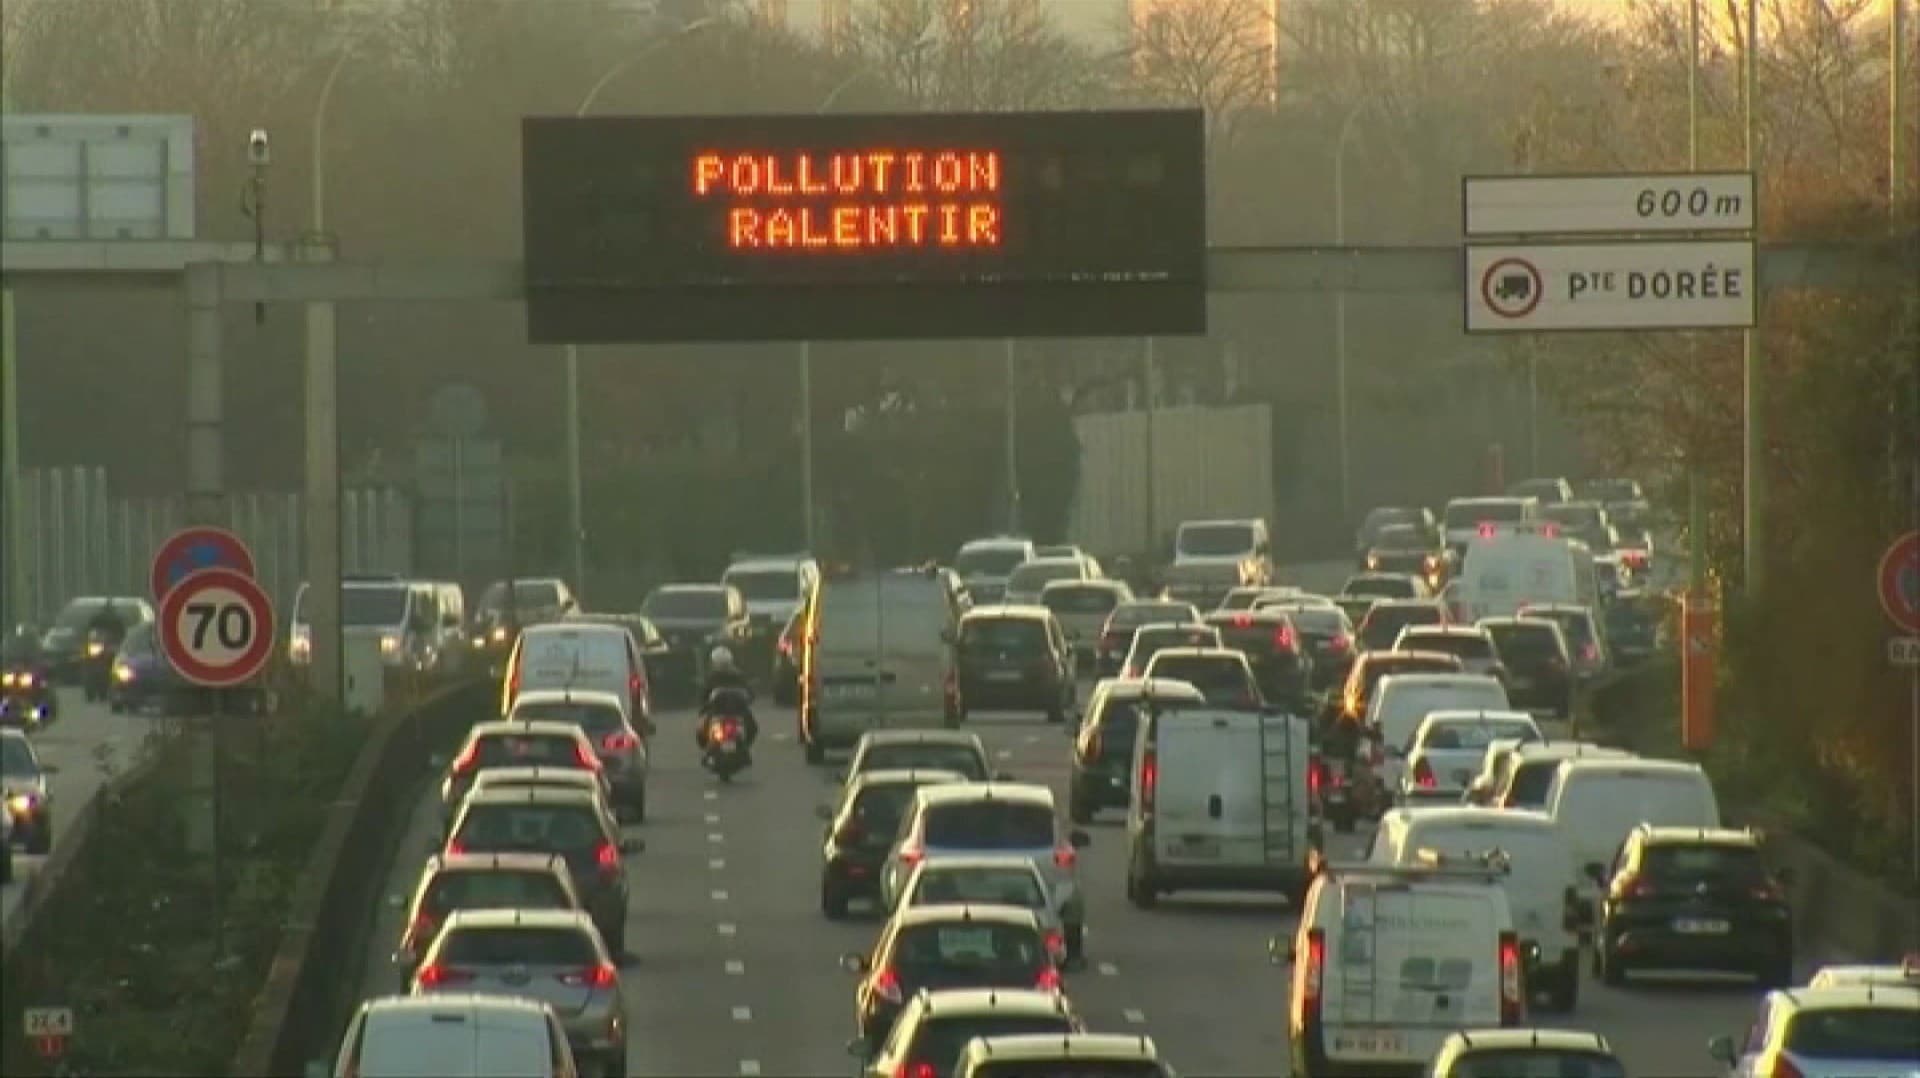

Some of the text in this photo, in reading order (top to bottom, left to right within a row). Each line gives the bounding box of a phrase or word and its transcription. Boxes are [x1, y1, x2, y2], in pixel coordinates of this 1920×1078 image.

[694, 150, 1000, 196] POLLUTION
[728, 203, 1001, 248] RALENTIR
[1627, 261, 1743, 299] DORÉE
[186, 603, 252, 649] 70
